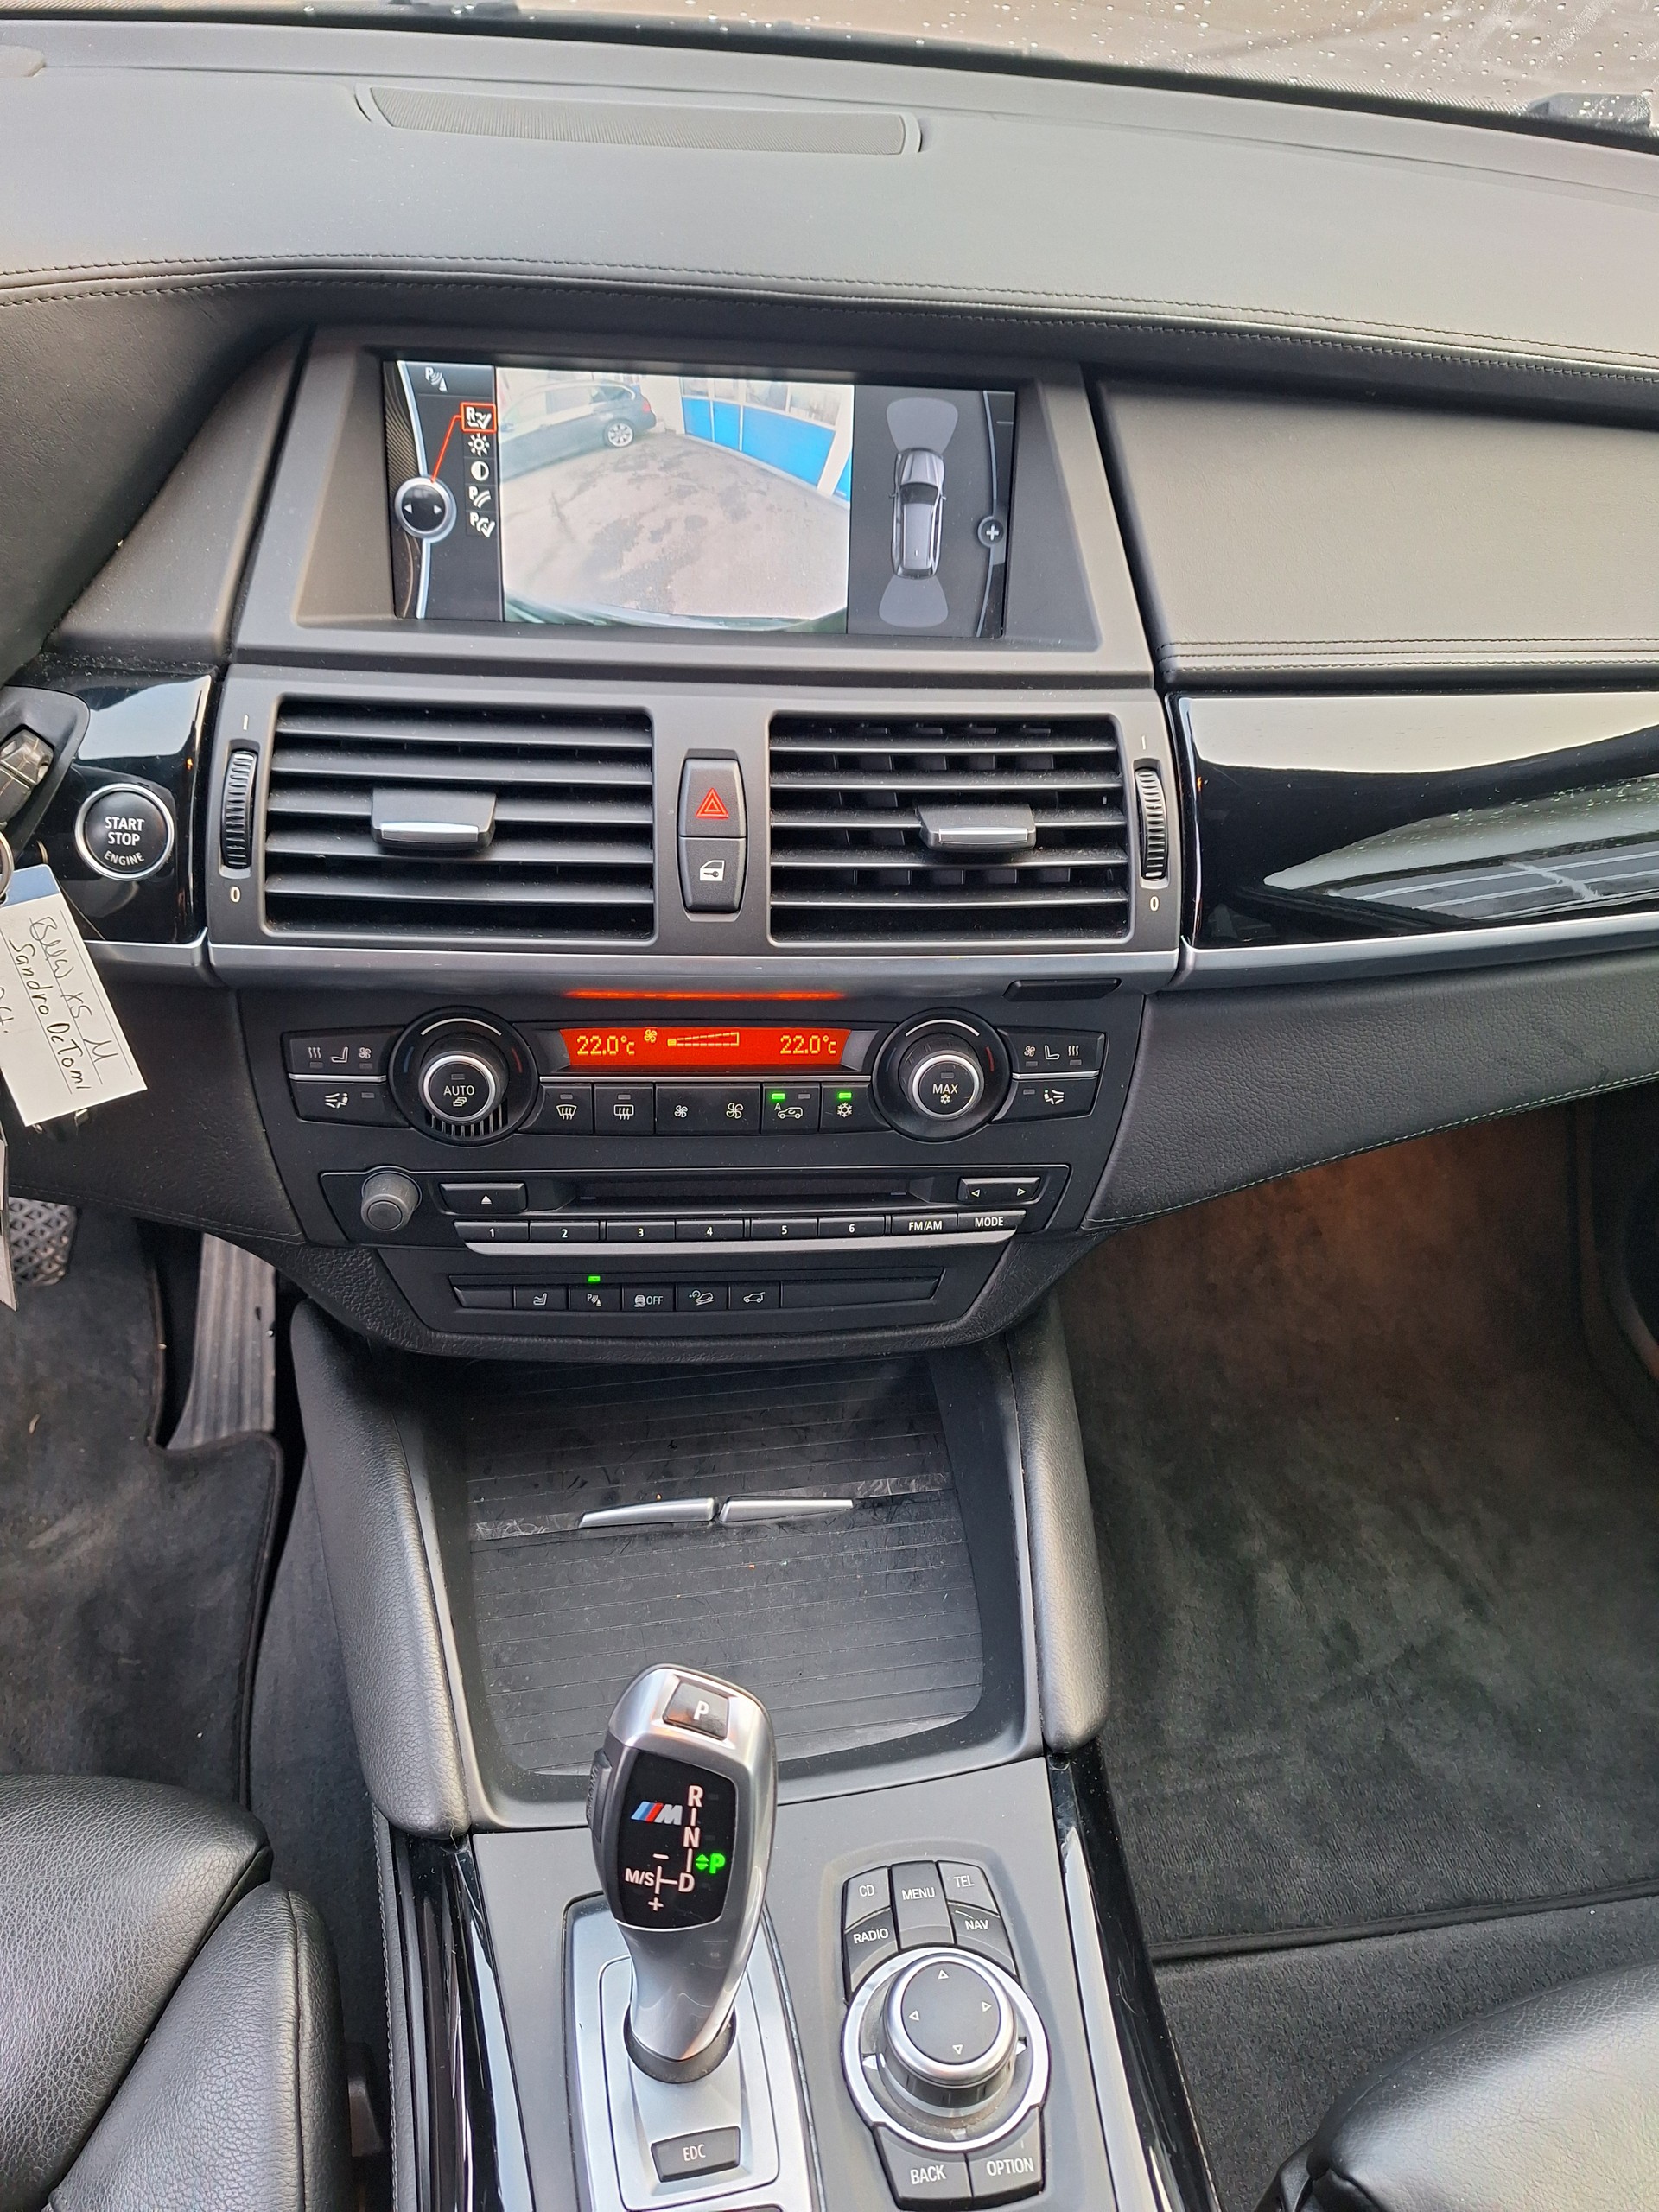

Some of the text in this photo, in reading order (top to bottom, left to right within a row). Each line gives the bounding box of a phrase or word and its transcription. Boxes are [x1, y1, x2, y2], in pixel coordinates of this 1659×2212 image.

[105, 817, 145, 831] START
[108, 832, 141, 846] STOP
[104, 850, 145, 866] ENGINE
[9, 939, 54, 1015] Sandro
[443, 1084, 475, 1097] AUTO
[932, 1084, 958, 1096] MAX
[849, 1223, 855, 1232] 6
[908, 1220, 944, 1232] FM/AM
[975, 1216, 1005, 1227] MODE
[489, 1228, 495, 1238] 1
[562, 1228, 568, 1238] 2
[638, 1228, 644, 1238] 3
[706, 1227, 713, 1236] 4
[781, 1224, 788, 1234] 5
[645, 1295, 664, 1306] OFF
[693, 1700, 710, 1721] P
[688, 1785, 703, 1808] R
[683, 1827, 701, 1848] N
[709, 1853, 726, 1874] P
[625, 1867, 655, 1887] M/S
[678, 1872, 696, 1892] D
[953, 1874, 976, 1889] TEL
[858, 1884, 875, 1898] CD
[901, 1885, 937, 1901] MENU
[965, 1918, 989, 1931] NAV
[853, 1928, 889, 1945] RADIO
[683, 2144, 706, 2162] EDC
[986, 2156, 1034, 2177] OPTION
[910, 2164, 947, 2185] BACK
